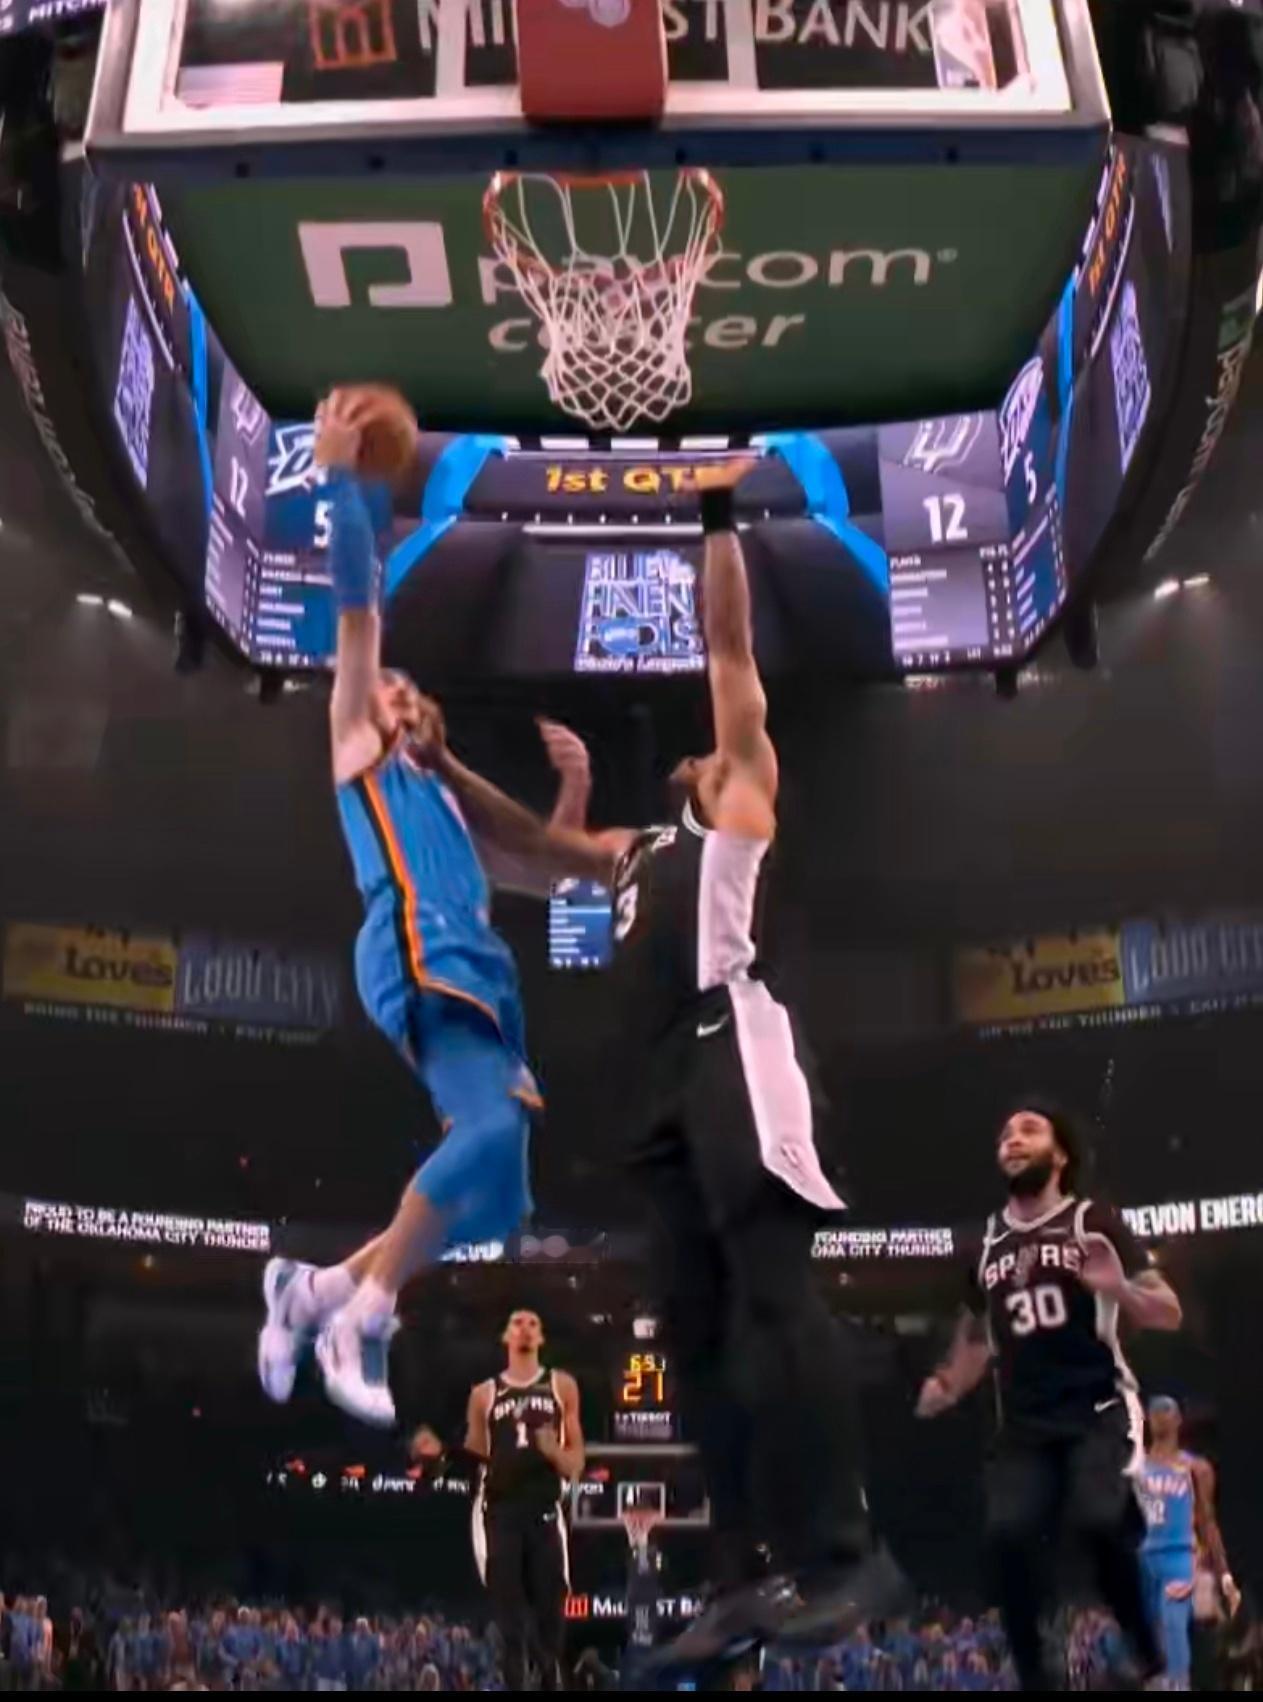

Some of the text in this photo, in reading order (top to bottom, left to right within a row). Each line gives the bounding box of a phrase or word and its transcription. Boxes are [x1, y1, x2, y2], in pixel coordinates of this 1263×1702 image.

[546, 464, 608, 493] 1st
[923, 493, 968, 543] 12
[47, 1219, 74, 1235] THE
[78, 1221, 162, 1242] OKLAHOMA
[165, 1229, 199, 1245] CITY
[203, 1233, 270, 1253] THUNDER
[76, 1205, 96, 1221] TO
[207, 1217, 269, 1237] PARTNER
[849, 1242, 882, 1257] CITY
[886, 1240, 954, 1256] THUNDER
[1005, 1284, 1068, 1336] 30
[516, 1421, 529, 1448] 1
